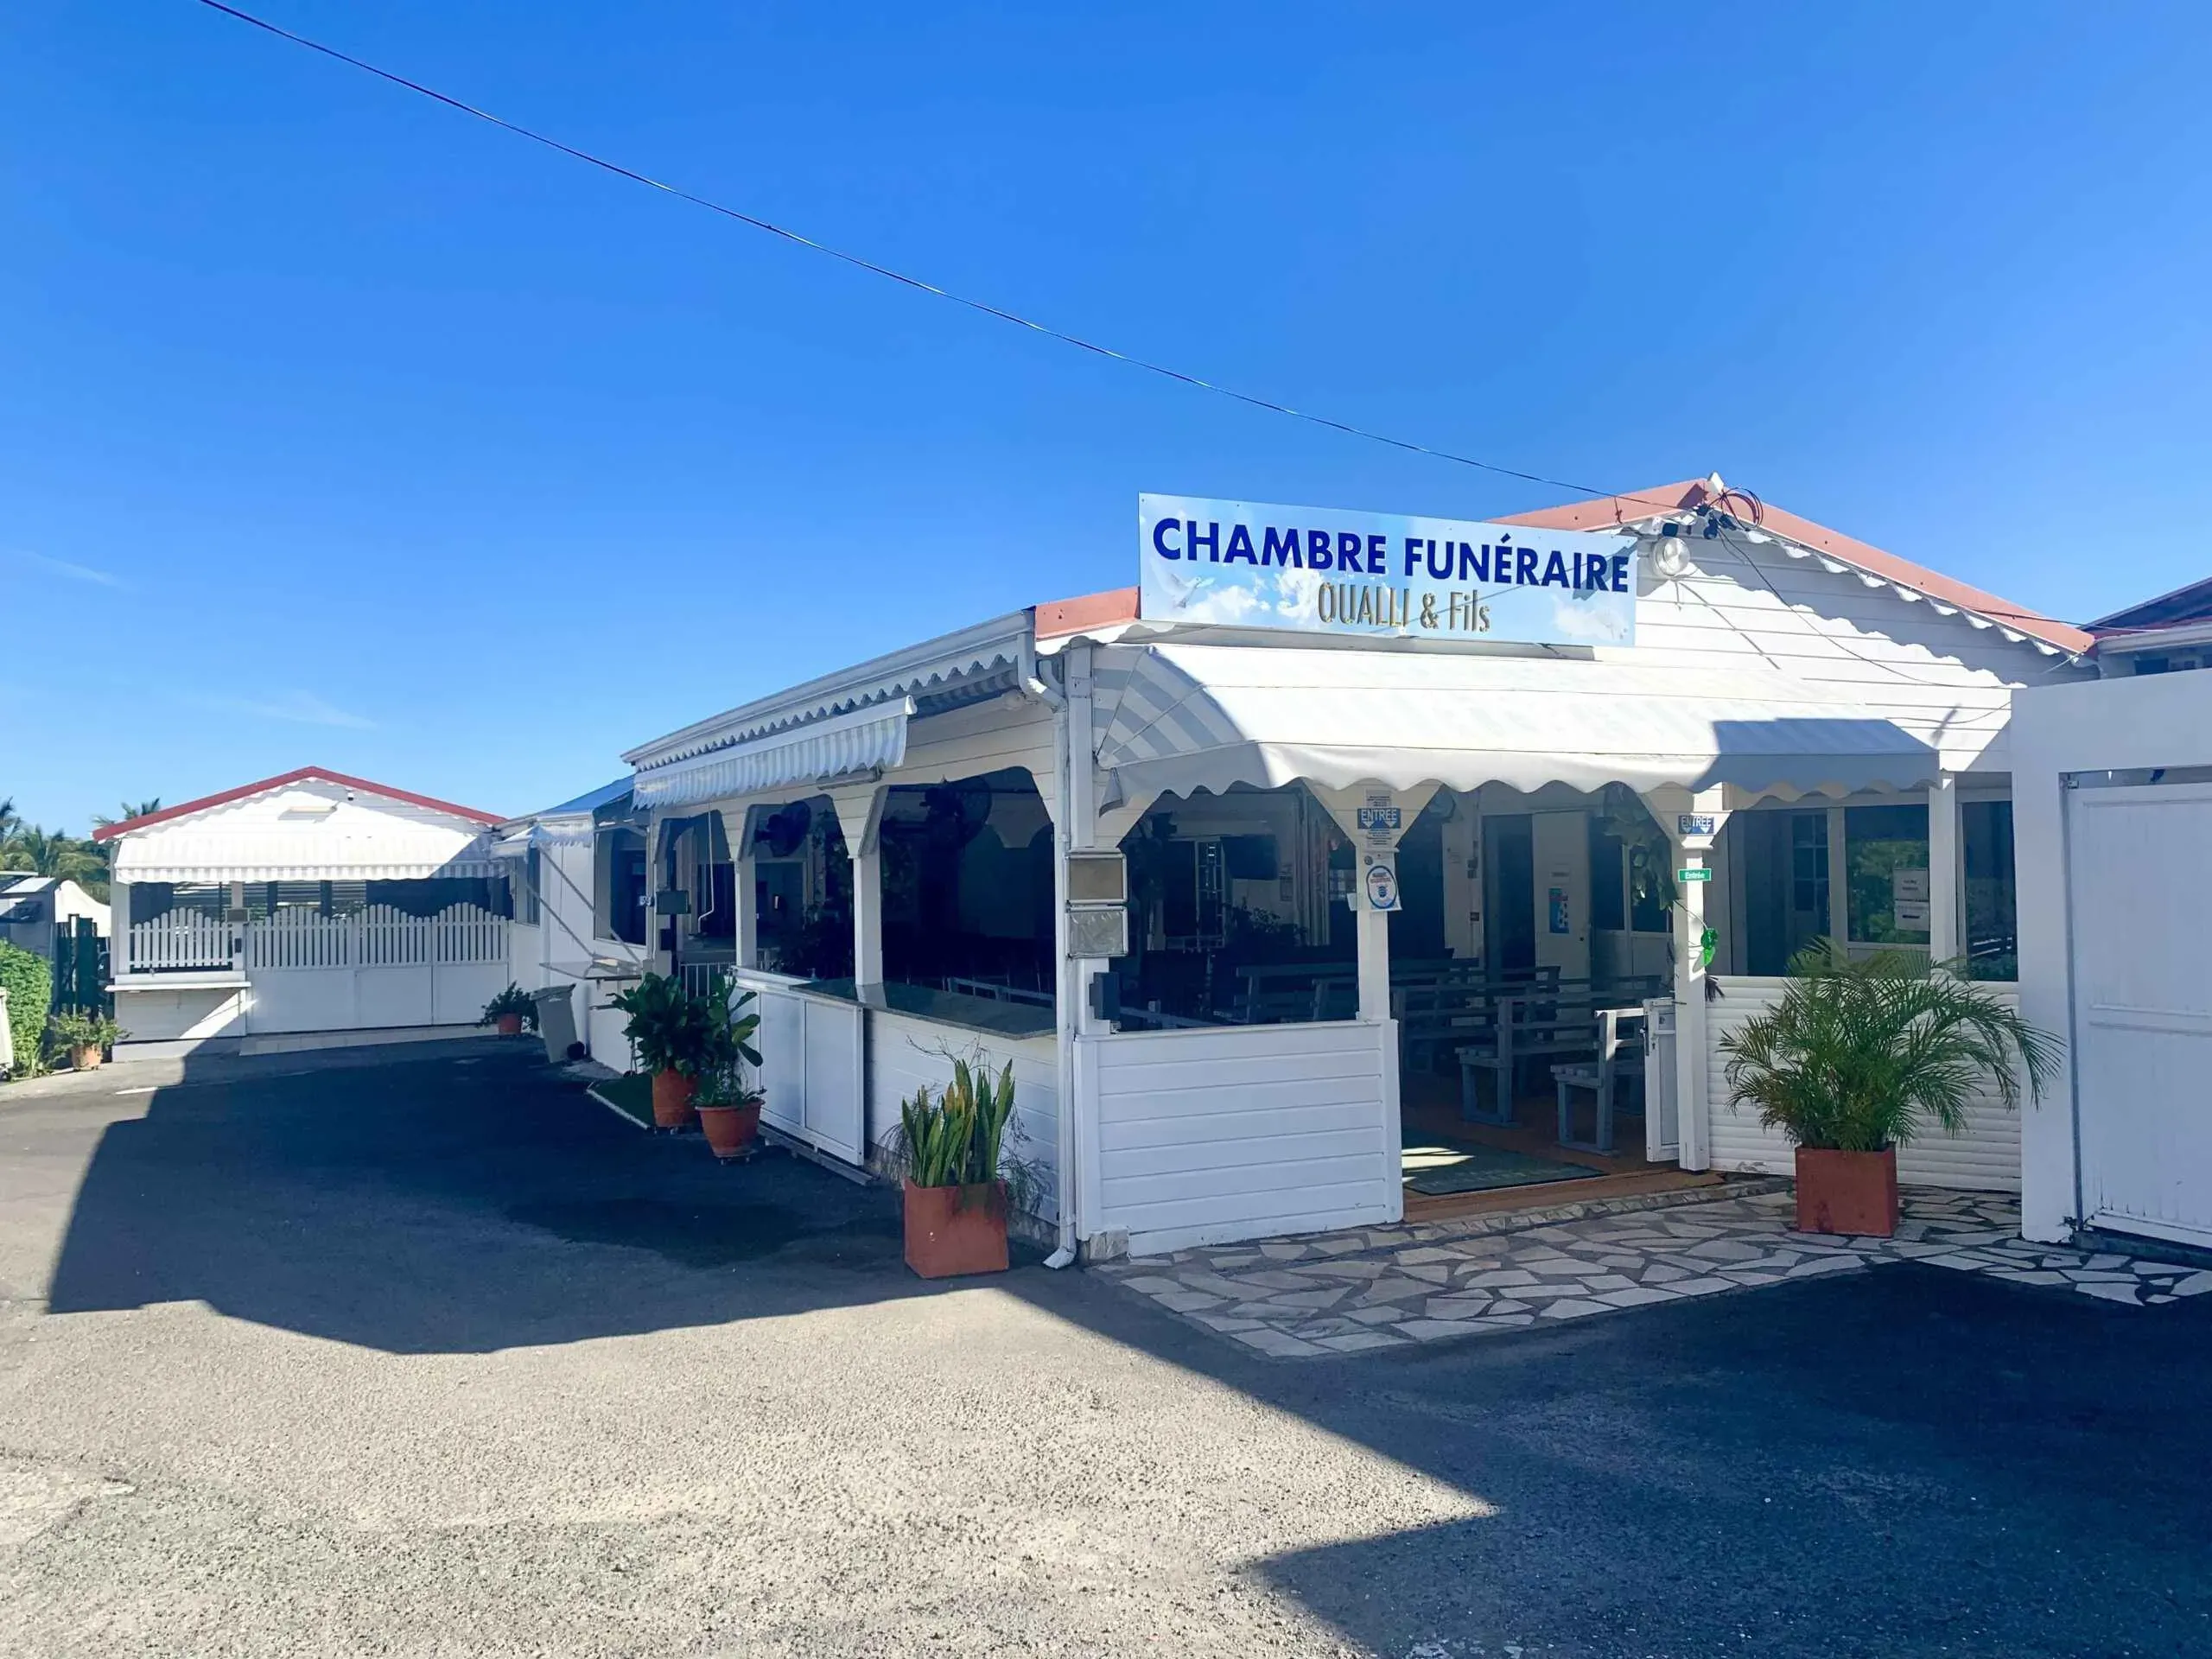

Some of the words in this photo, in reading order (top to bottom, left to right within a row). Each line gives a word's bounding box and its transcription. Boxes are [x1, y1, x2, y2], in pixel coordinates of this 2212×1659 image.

[1153, 518, 1386, 574] CHAMBRE
[1404, 532, 1629, 594] FUNÉRAIRE
[1420, 593, 1440, 630] &
[1449, 589, 1491, 632] Fils
